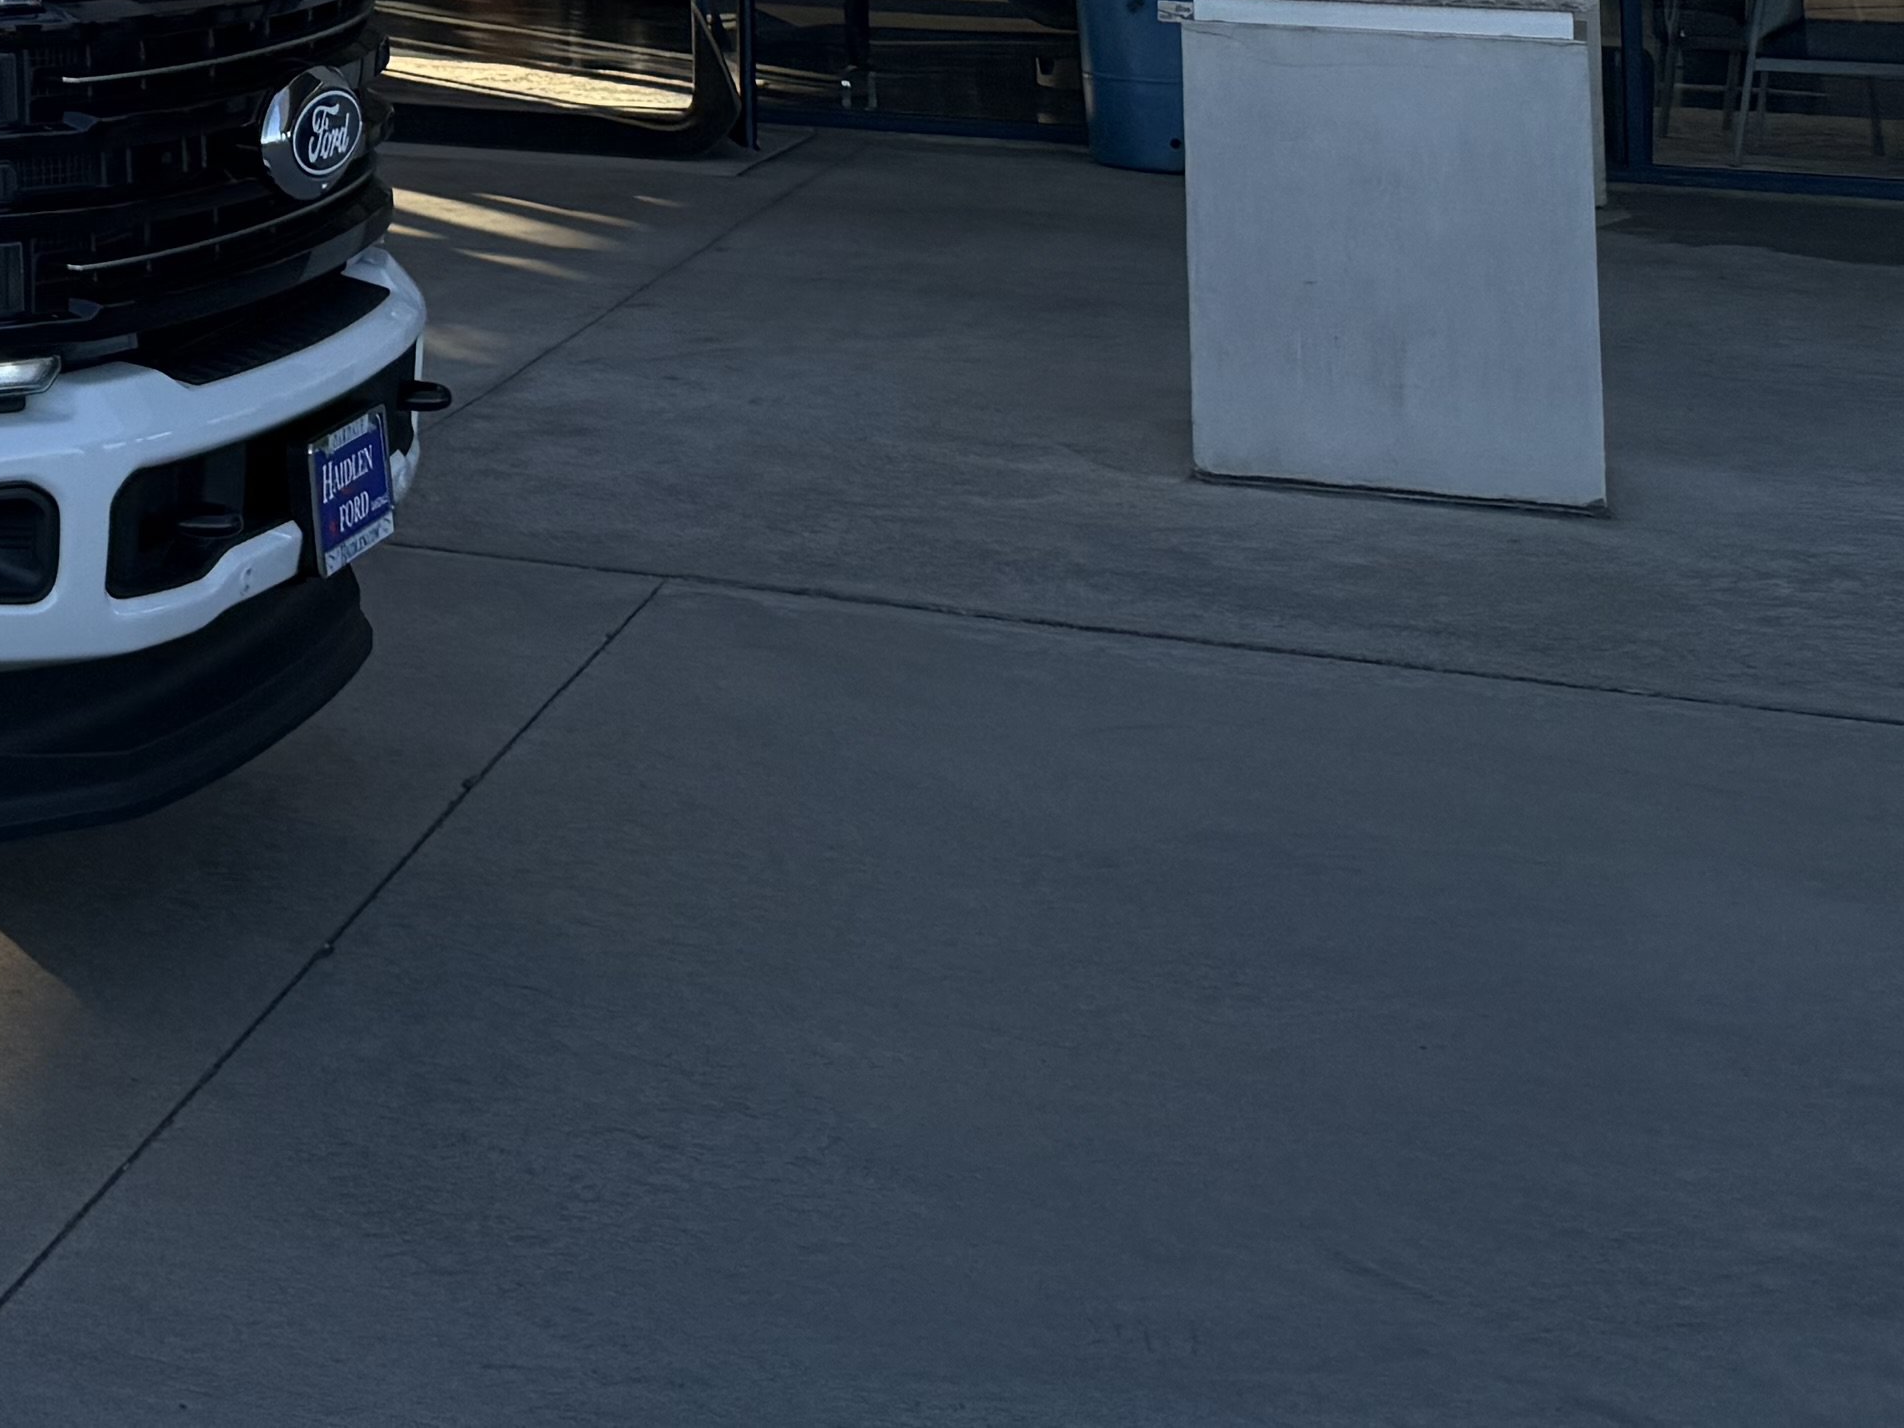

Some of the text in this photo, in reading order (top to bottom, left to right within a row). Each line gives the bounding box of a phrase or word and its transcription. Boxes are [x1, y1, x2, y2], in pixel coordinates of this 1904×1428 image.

[308, 103, 350, 163] Ford
[322, 444, 374, 504] HAIDLEN
[339, 490, 370, 533] FORD
